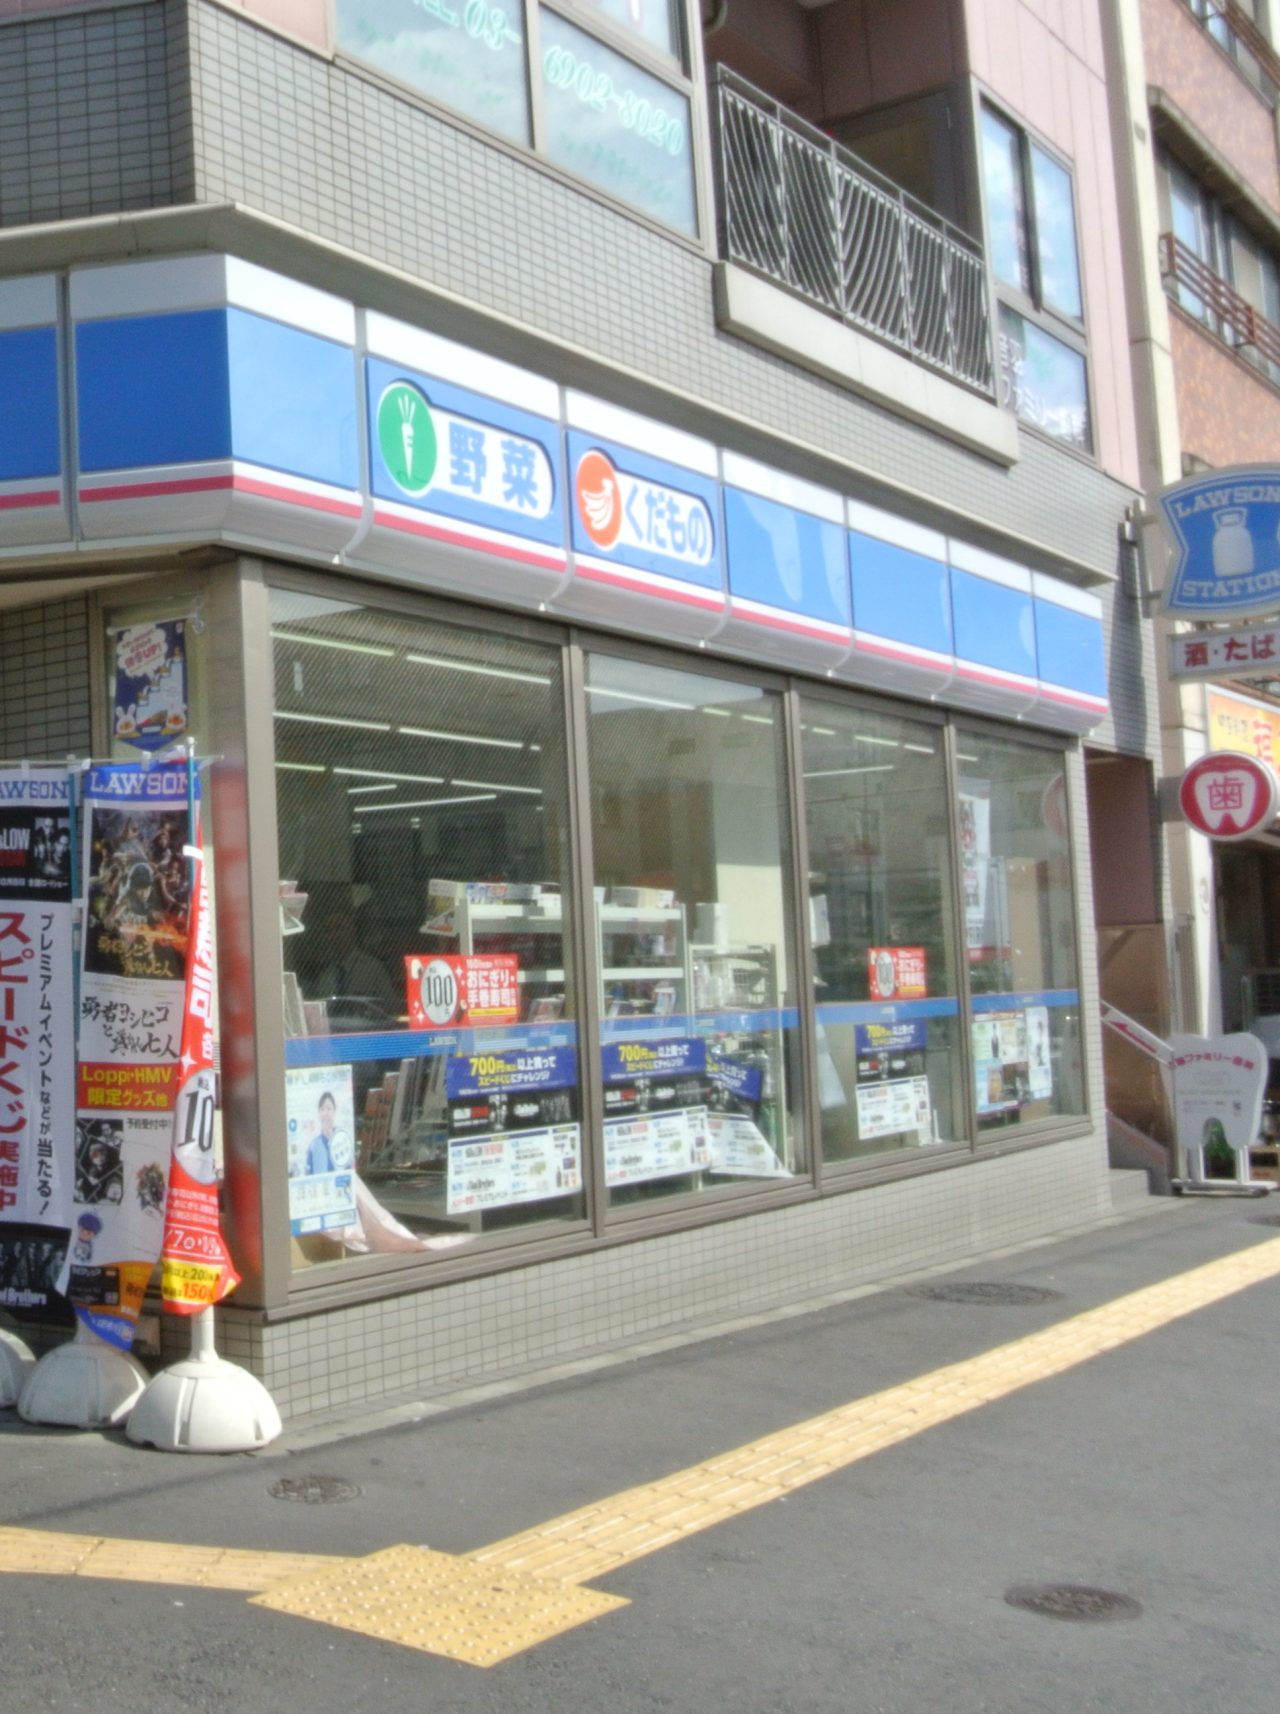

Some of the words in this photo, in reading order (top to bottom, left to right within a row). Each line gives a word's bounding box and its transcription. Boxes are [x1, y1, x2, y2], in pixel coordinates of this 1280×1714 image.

[449, 421, 539, 511] 野菜
[625, 483, 709, 560] くだもの
[89, 770, 200, 795] LAWSON
[1207, 775, 1244, 811] 歯
